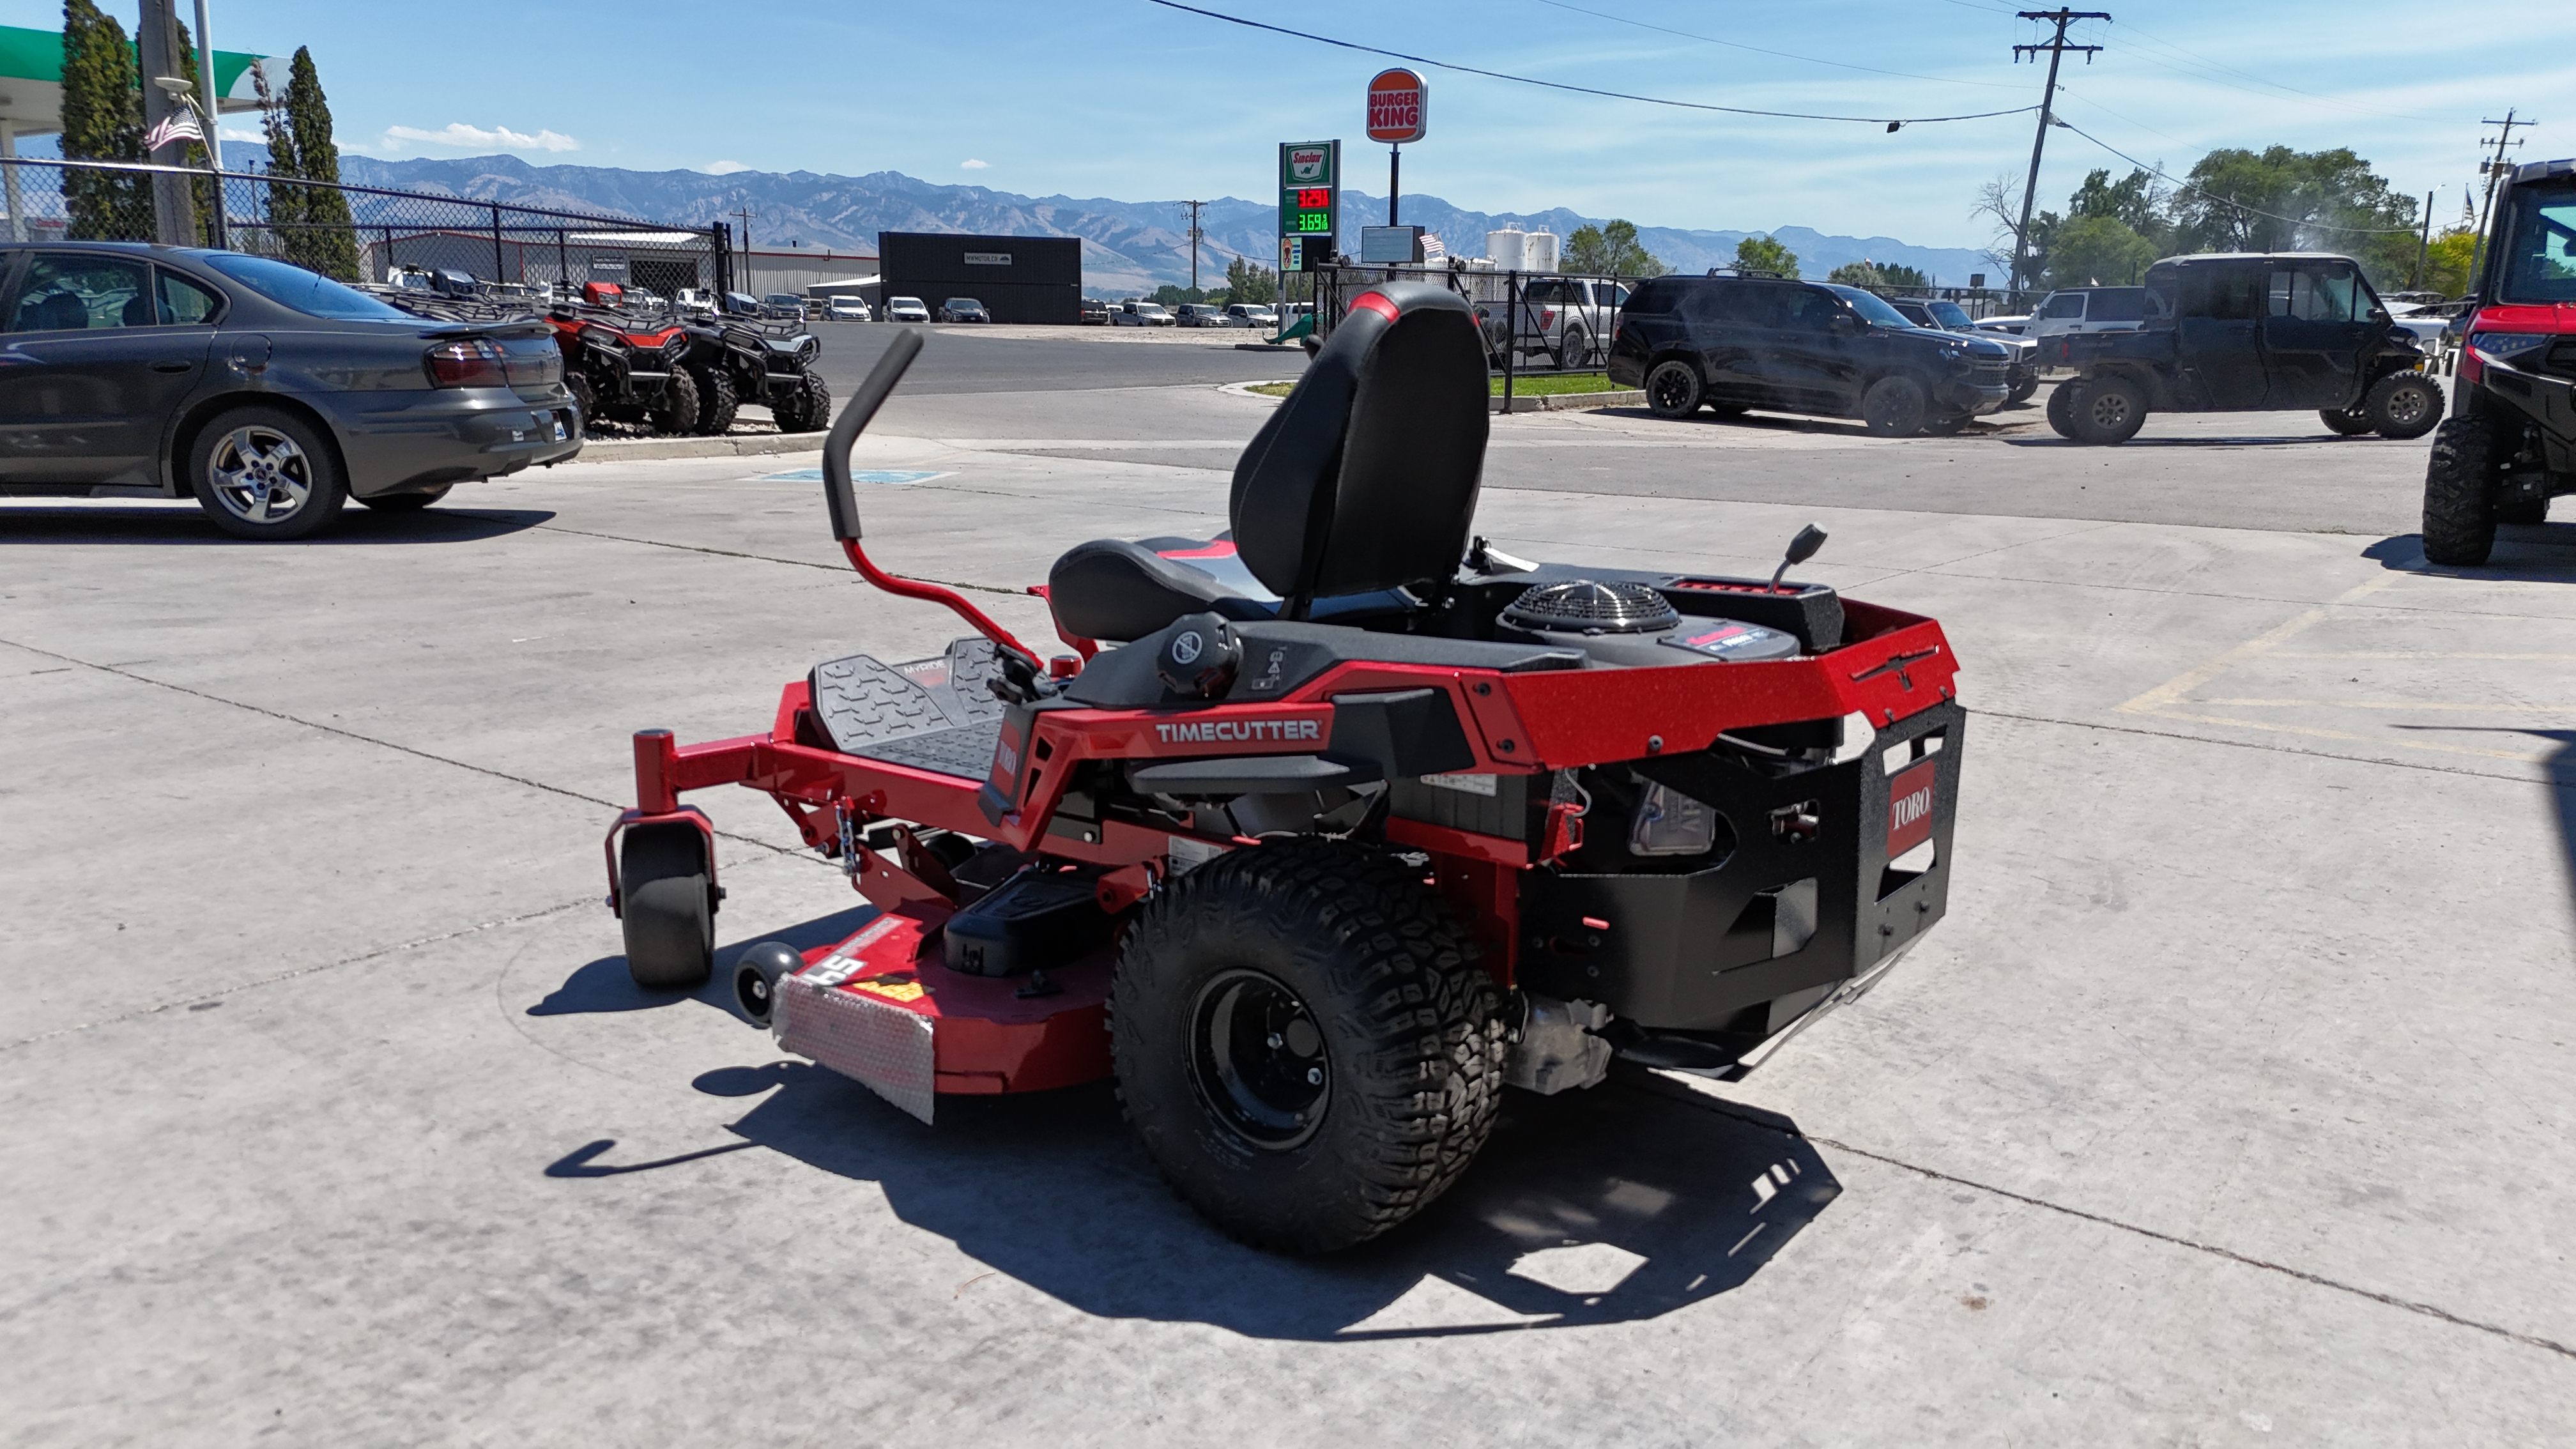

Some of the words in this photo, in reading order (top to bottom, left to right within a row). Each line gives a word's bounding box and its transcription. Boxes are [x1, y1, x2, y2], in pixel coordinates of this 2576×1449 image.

[1370, 92, 1419, 107] BURGER
[1369, 107, 1418, 128] KING
[1293, 152, 1322, 164] Sinclair
[1299, 213, 1321, 230] 3.69
[1156, 719, 1320, 742] TIMECUTTER
[1892, 786, 1930, 830] TORO
